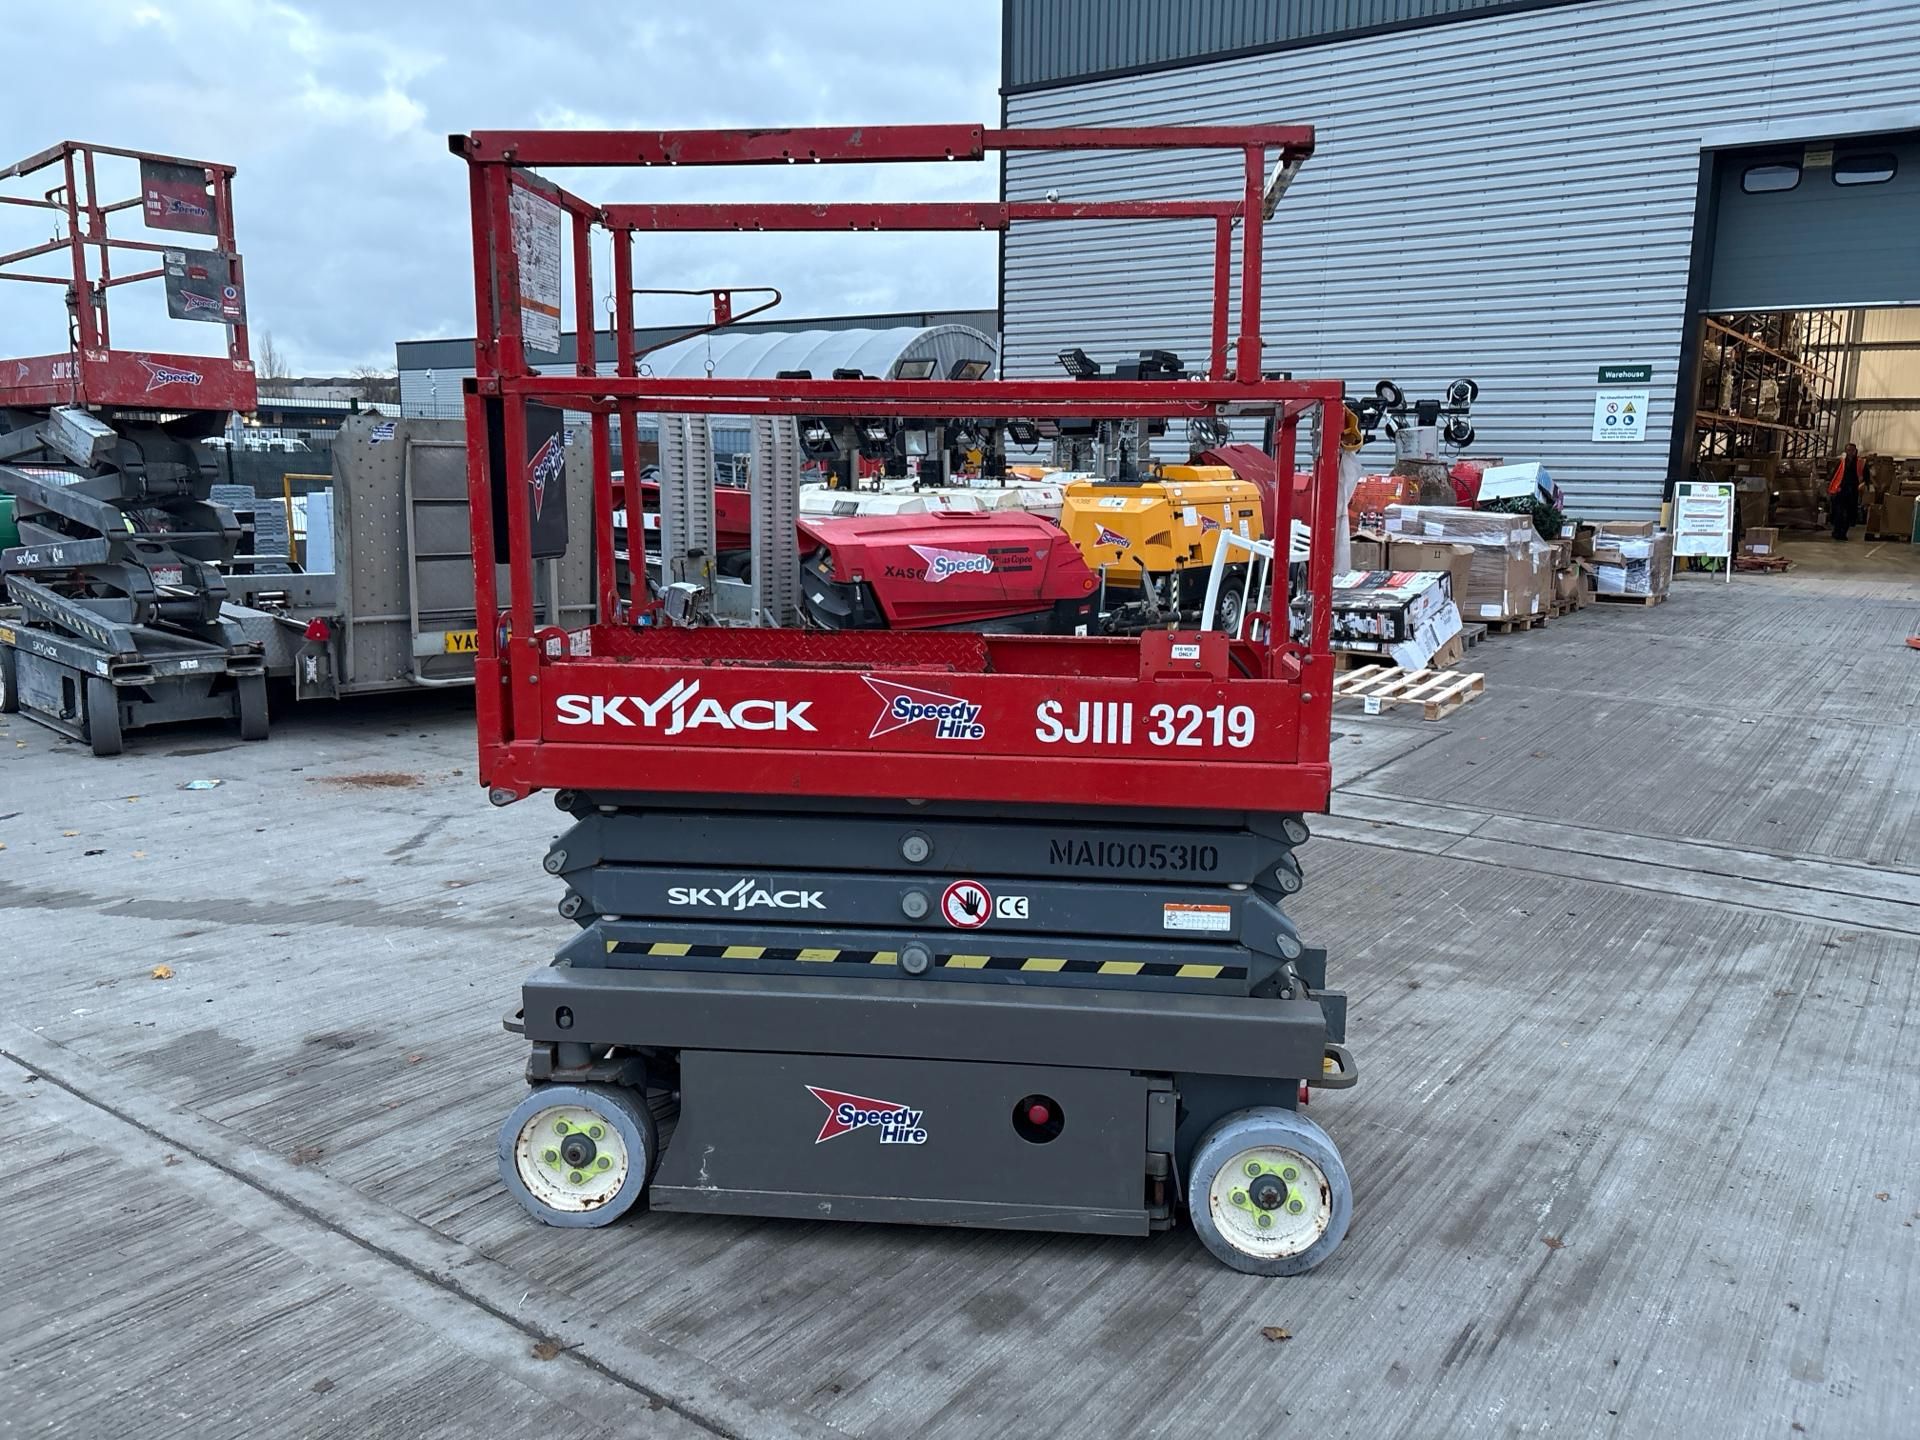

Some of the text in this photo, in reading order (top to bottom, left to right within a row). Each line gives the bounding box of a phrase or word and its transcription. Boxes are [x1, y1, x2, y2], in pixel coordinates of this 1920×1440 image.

[157, 372, 202, 385] Speedy
[1605, 370, 1645, 379] Warehouse
[533, 437, 560, 489] Speedy
[1102, 532, 1131, 548] Speedy
[16, 550, 40, 566] SKYJACK
[934, 557, 992, 575] Speedy
[32, 640, 58, 658] SKYJACK
[556, 678, 818, 736] SKYJACK
[892, 696, 979, 722] Speedy
[938, 720, 984, 738] Hire
[1036, 700, 1256, 748] SJIII 3219
[668, 878, 827, 910] SKYJACK
[1000, 898, 1026, 916] CE
[838, 1104, 920, 1128] Speedy
[882, 1126, 926, 1142] Hire
